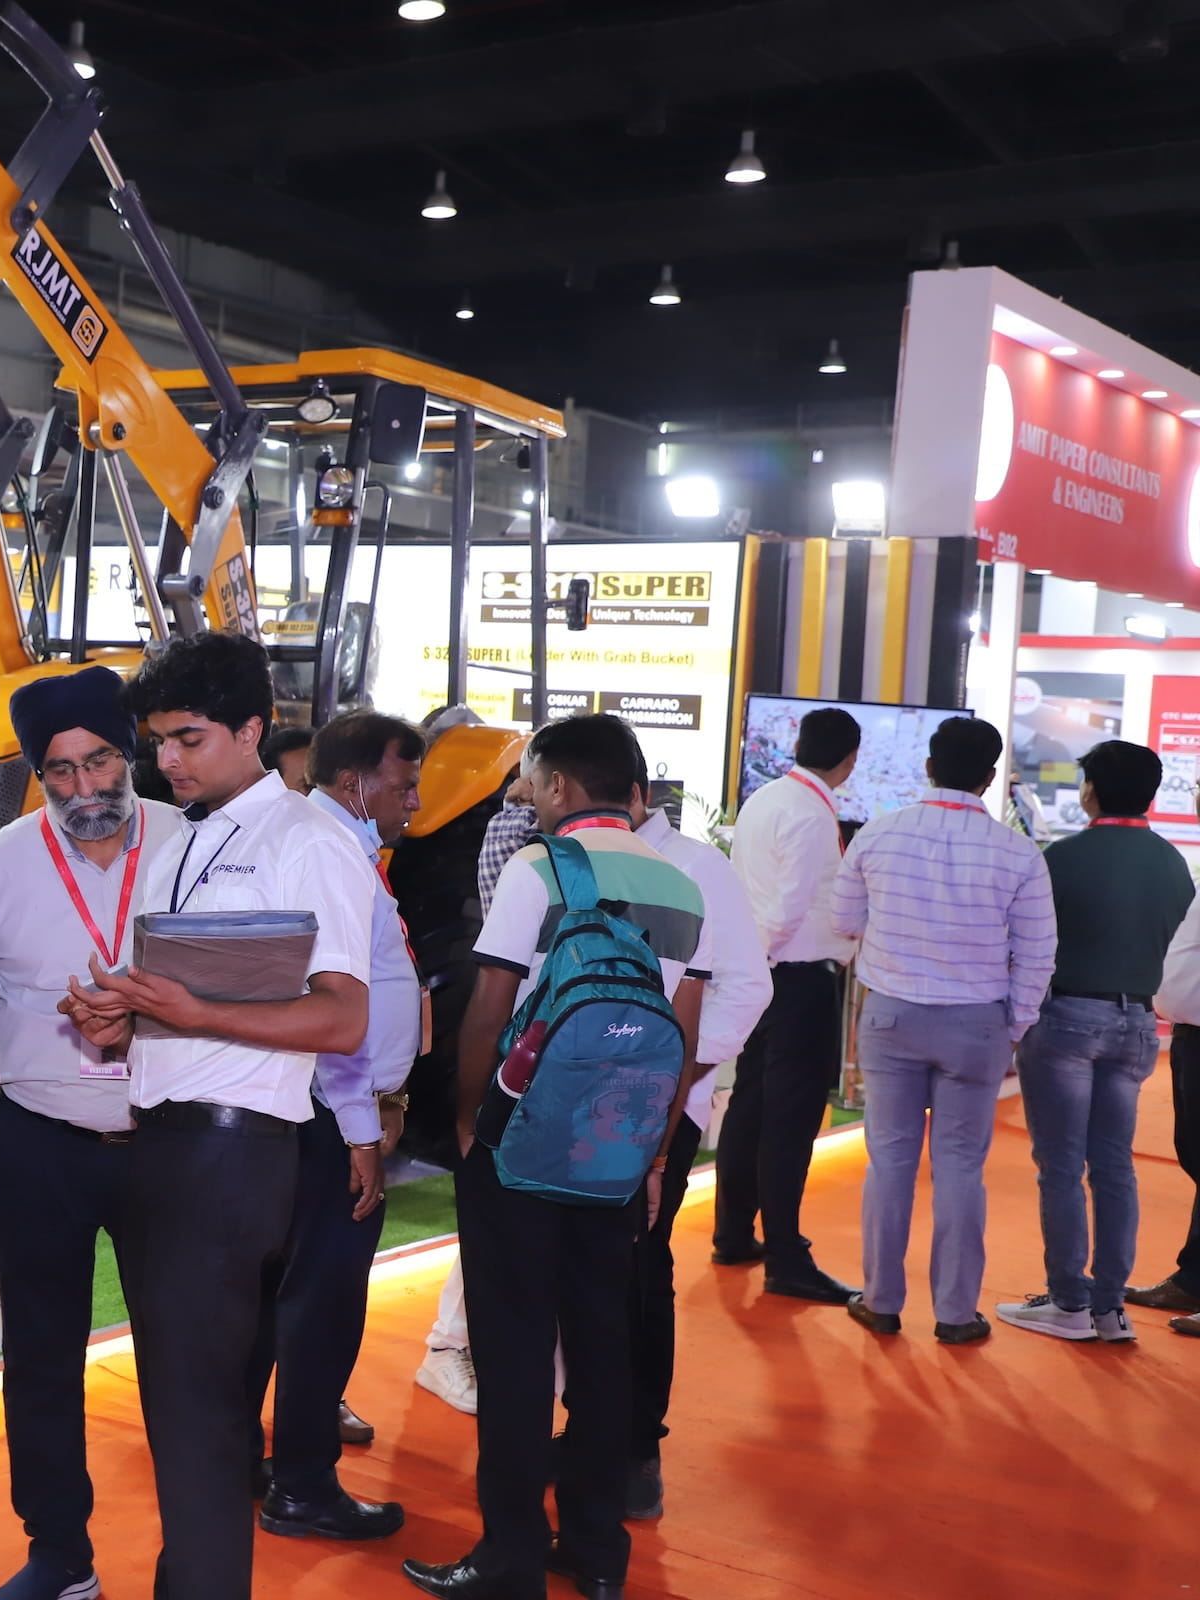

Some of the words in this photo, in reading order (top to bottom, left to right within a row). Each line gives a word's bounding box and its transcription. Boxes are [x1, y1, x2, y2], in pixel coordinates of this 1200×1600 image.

[19, 227, 82, 316] RJMT
[1017, 420, 1049, 459] AMIT
[1049, 433, 1088, 476] PAPER
[1089, 449, 1161, 500] CONSULTANTS
[1052, 475, 1062, 505] &
[1064, 479, 1126, 525] ENGINEERS
[620, 696, 680, 712] CARRARO
[218, 864, 256, 875] PREMIER
